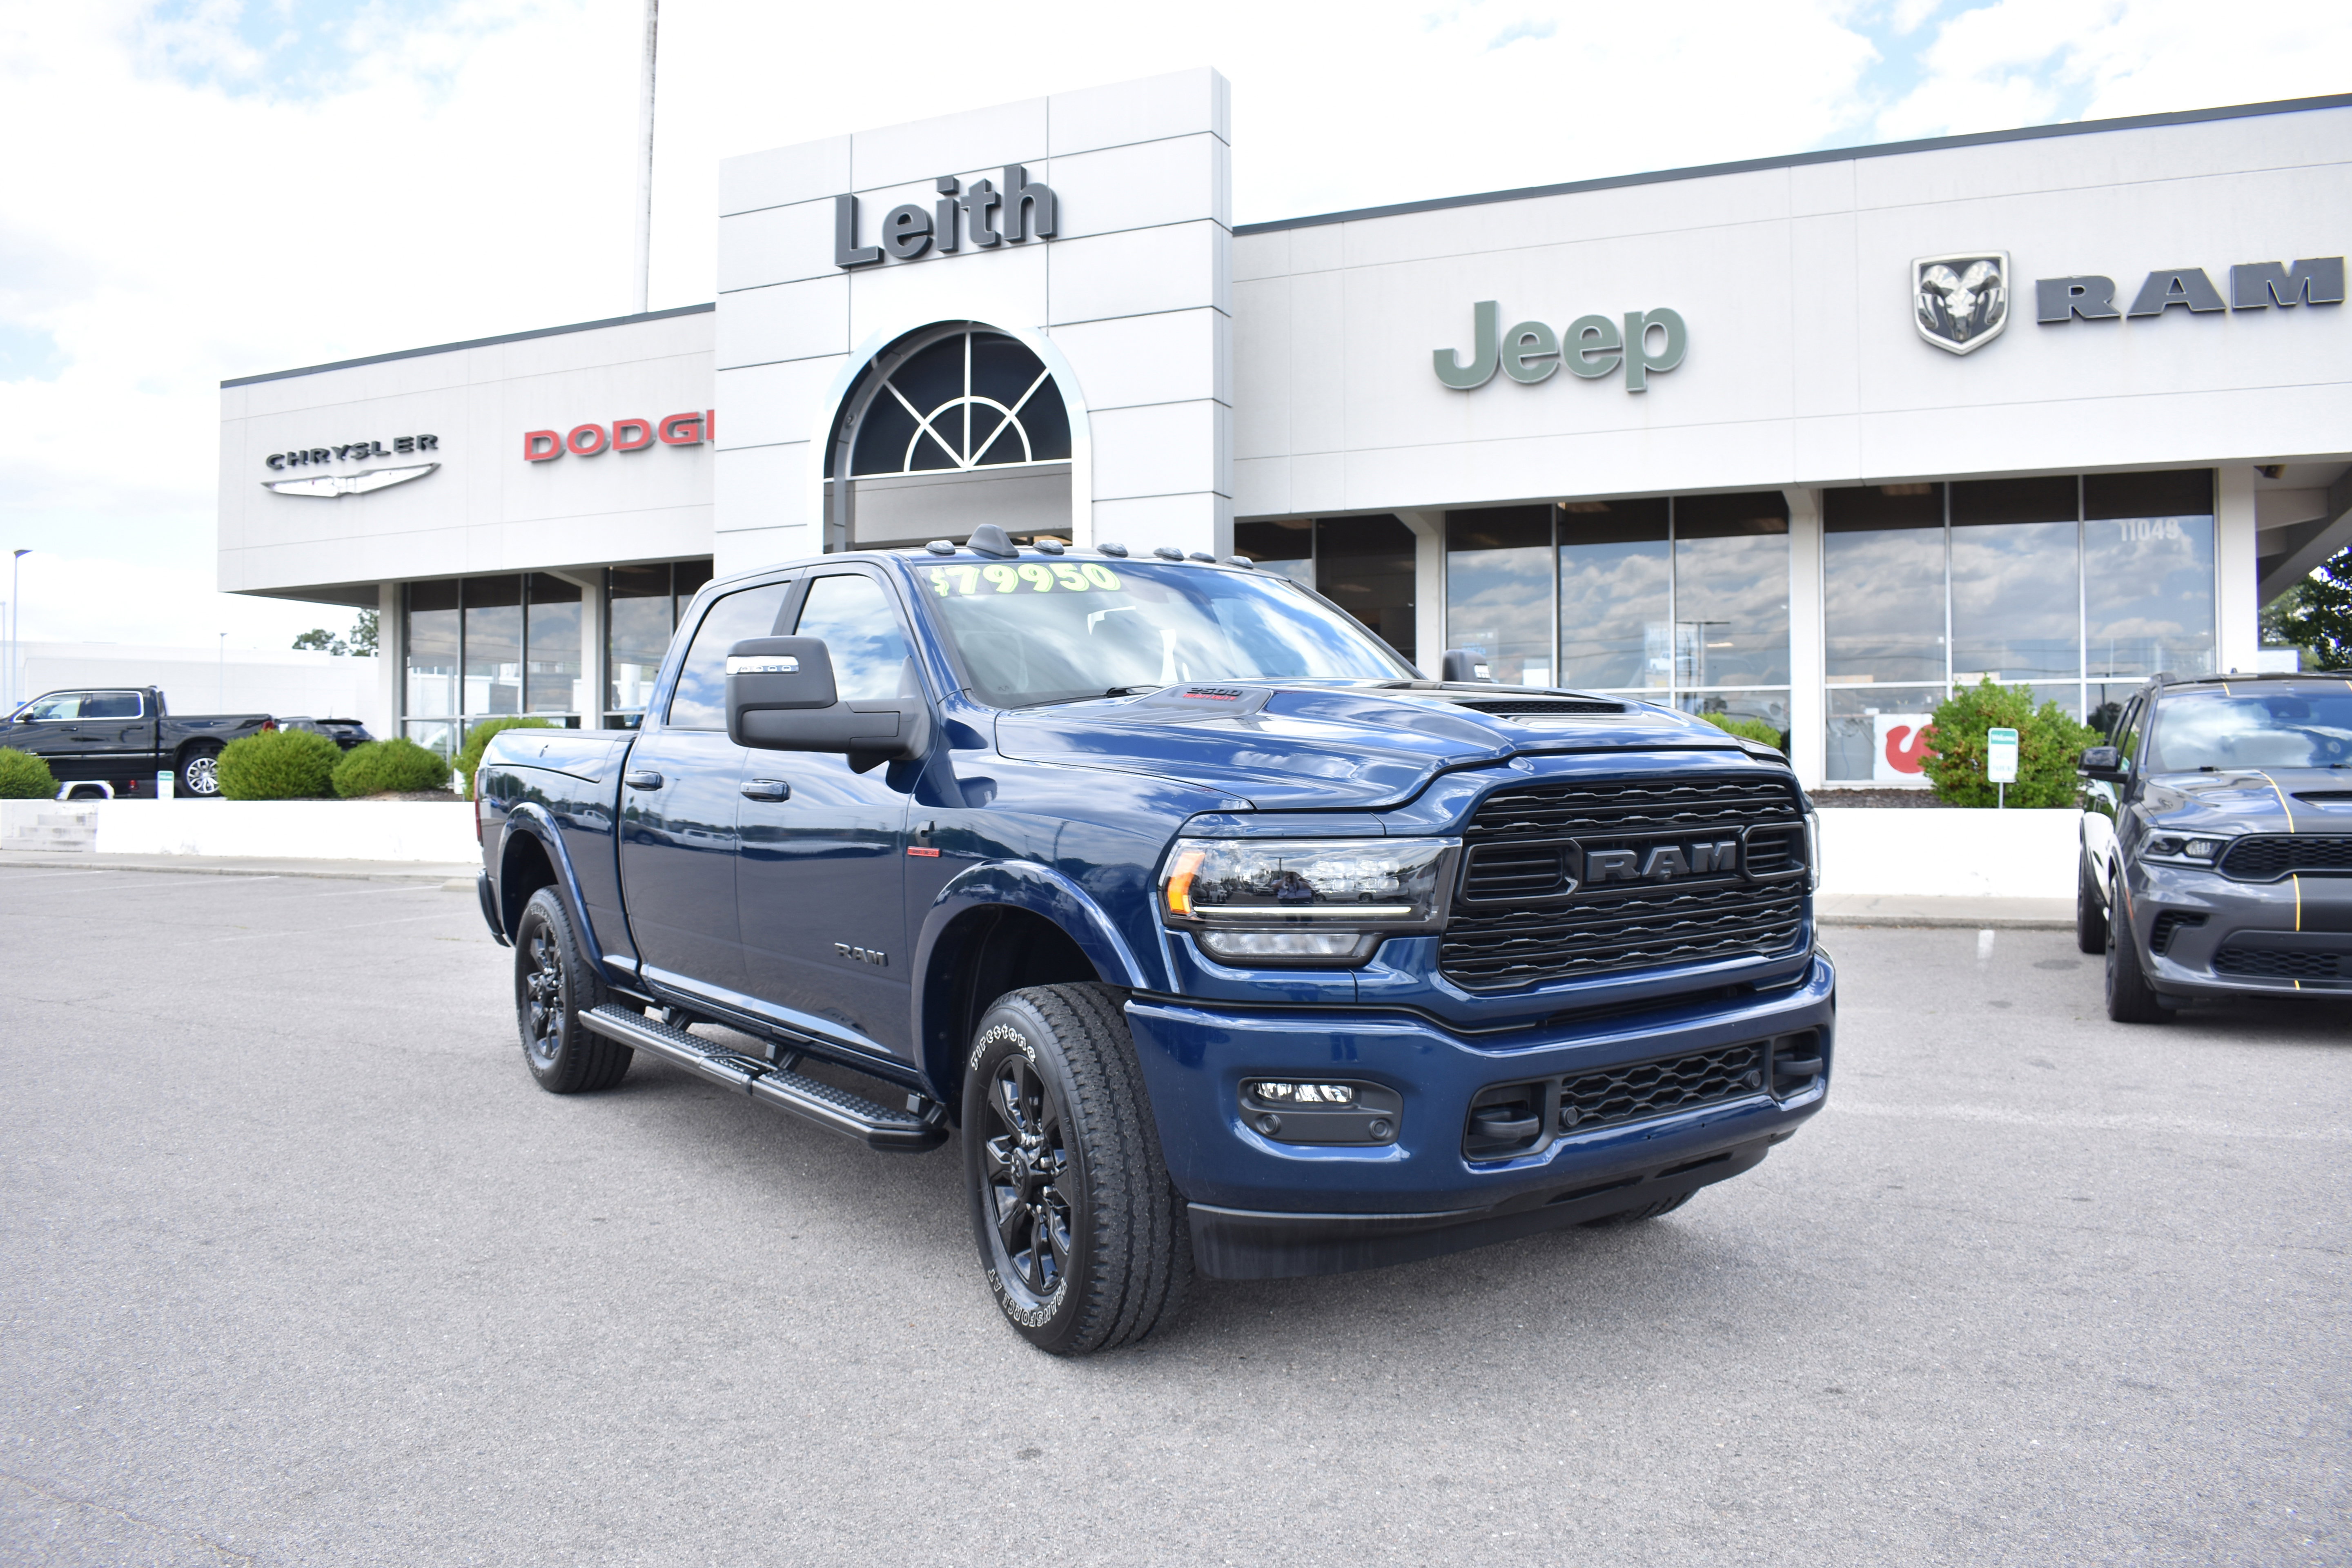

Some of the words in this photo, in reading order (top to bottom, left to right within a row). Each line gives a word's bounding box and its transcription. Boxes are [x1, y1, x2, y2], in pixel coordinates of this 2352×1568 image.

[835, 164, 1058, 269] Leith
[2036, 256, 2345, 324] RAM
[1433, 300, 1688, 393] Jeep
[266, 434, 439, 470] CHRYSLER
[524, 410, 714, 462] DODG
[930, 563, 1121, 597] $79950
[1187, 688, 1243, 696] 2500
[1587, 841, 1736, 881] RAM
[835, 942, 889, 967] RAM
[971, 1023, 1036, 1071] Firestone
[988, 1268, 1002, 1292] AT
[1002, 1277, 1068, 1327] TRANSFORCE
